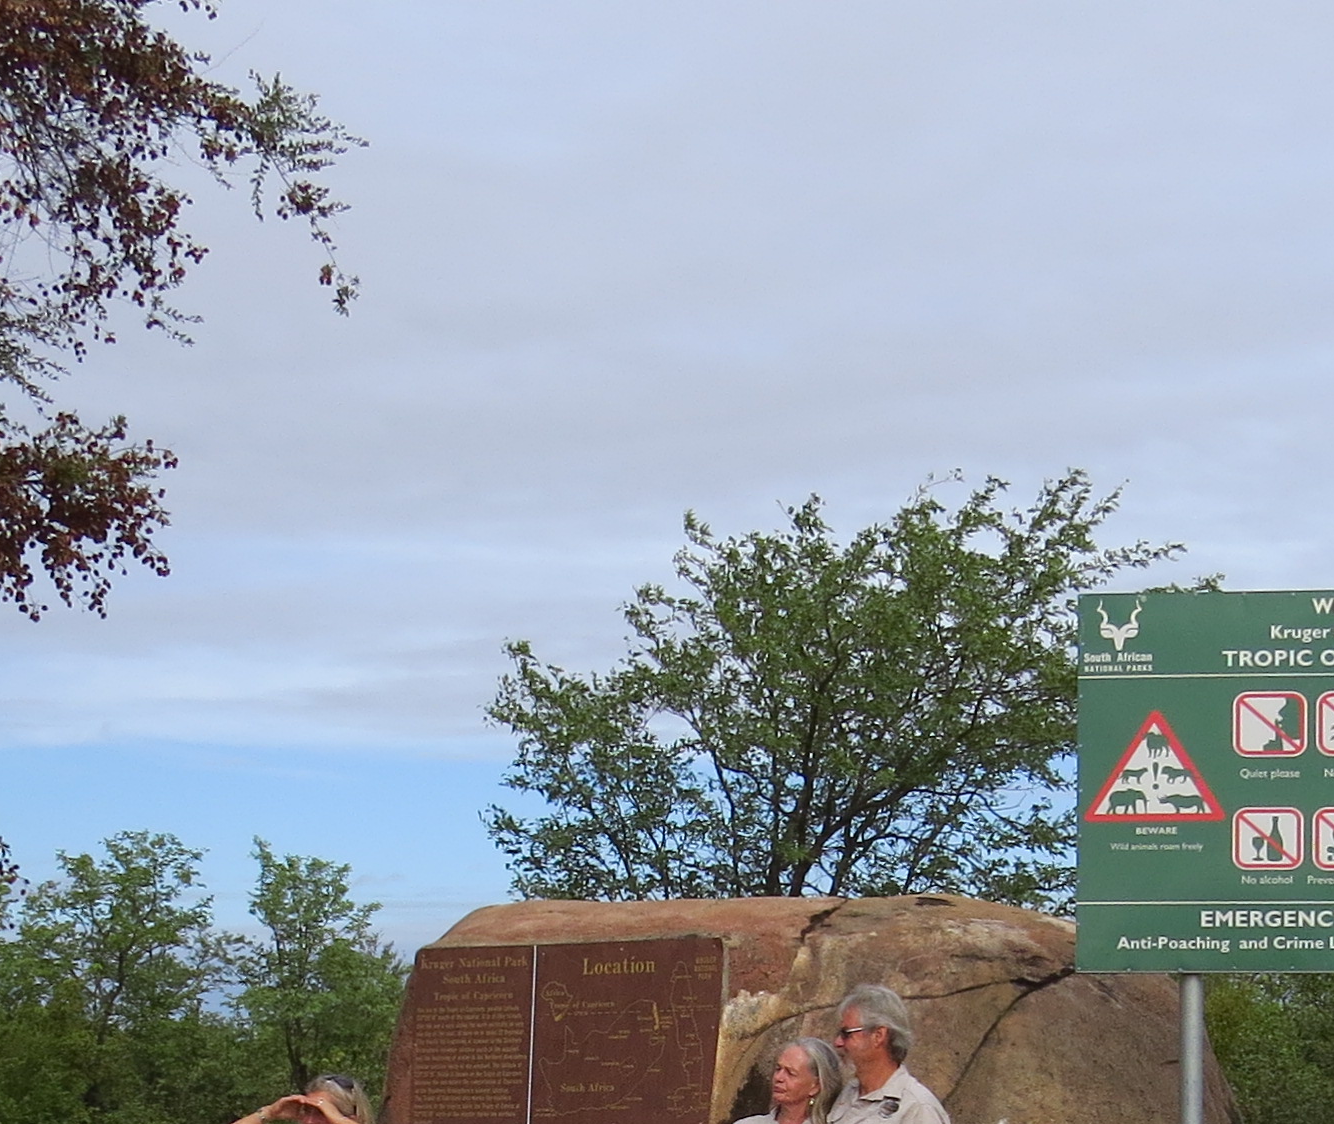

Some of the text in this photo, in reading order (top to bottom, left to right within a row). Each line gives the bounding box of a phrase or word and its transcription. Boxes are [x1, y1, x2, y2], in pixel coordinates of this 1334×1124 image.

[1270, 624, 1330, 643] Kruger
[1083, 651, 1153, 662] South African
[1222, 650, 1314, 668] TROPIC
[1084, 664, 1153, 673] NATIONAL PARKS
[1239, 768, 1301, 780] Quiet please
[1135, 826, 1177, 836] BEWARE
[1110, 842, 1129, 851] Wild
[1131, 842, 1157, 851] animals
[1181, 842, 1204, 853] freely
[1241, 875, 1293, 885] No alcohol
[1117, 936, 1230, 953] Anti-Poaching
[1239, 936, 1268, 950] and
[1273, 936, 1324, 950] Crime
[420, 955, 528, 970] Kruger National Park
[583, 957, 656, 975] Location
[443, 972, 505, 984] South Africa
[434, 991, 513, 1002] Tropic of Capricorn
[560, 1083, 615, 1092] South Africa
